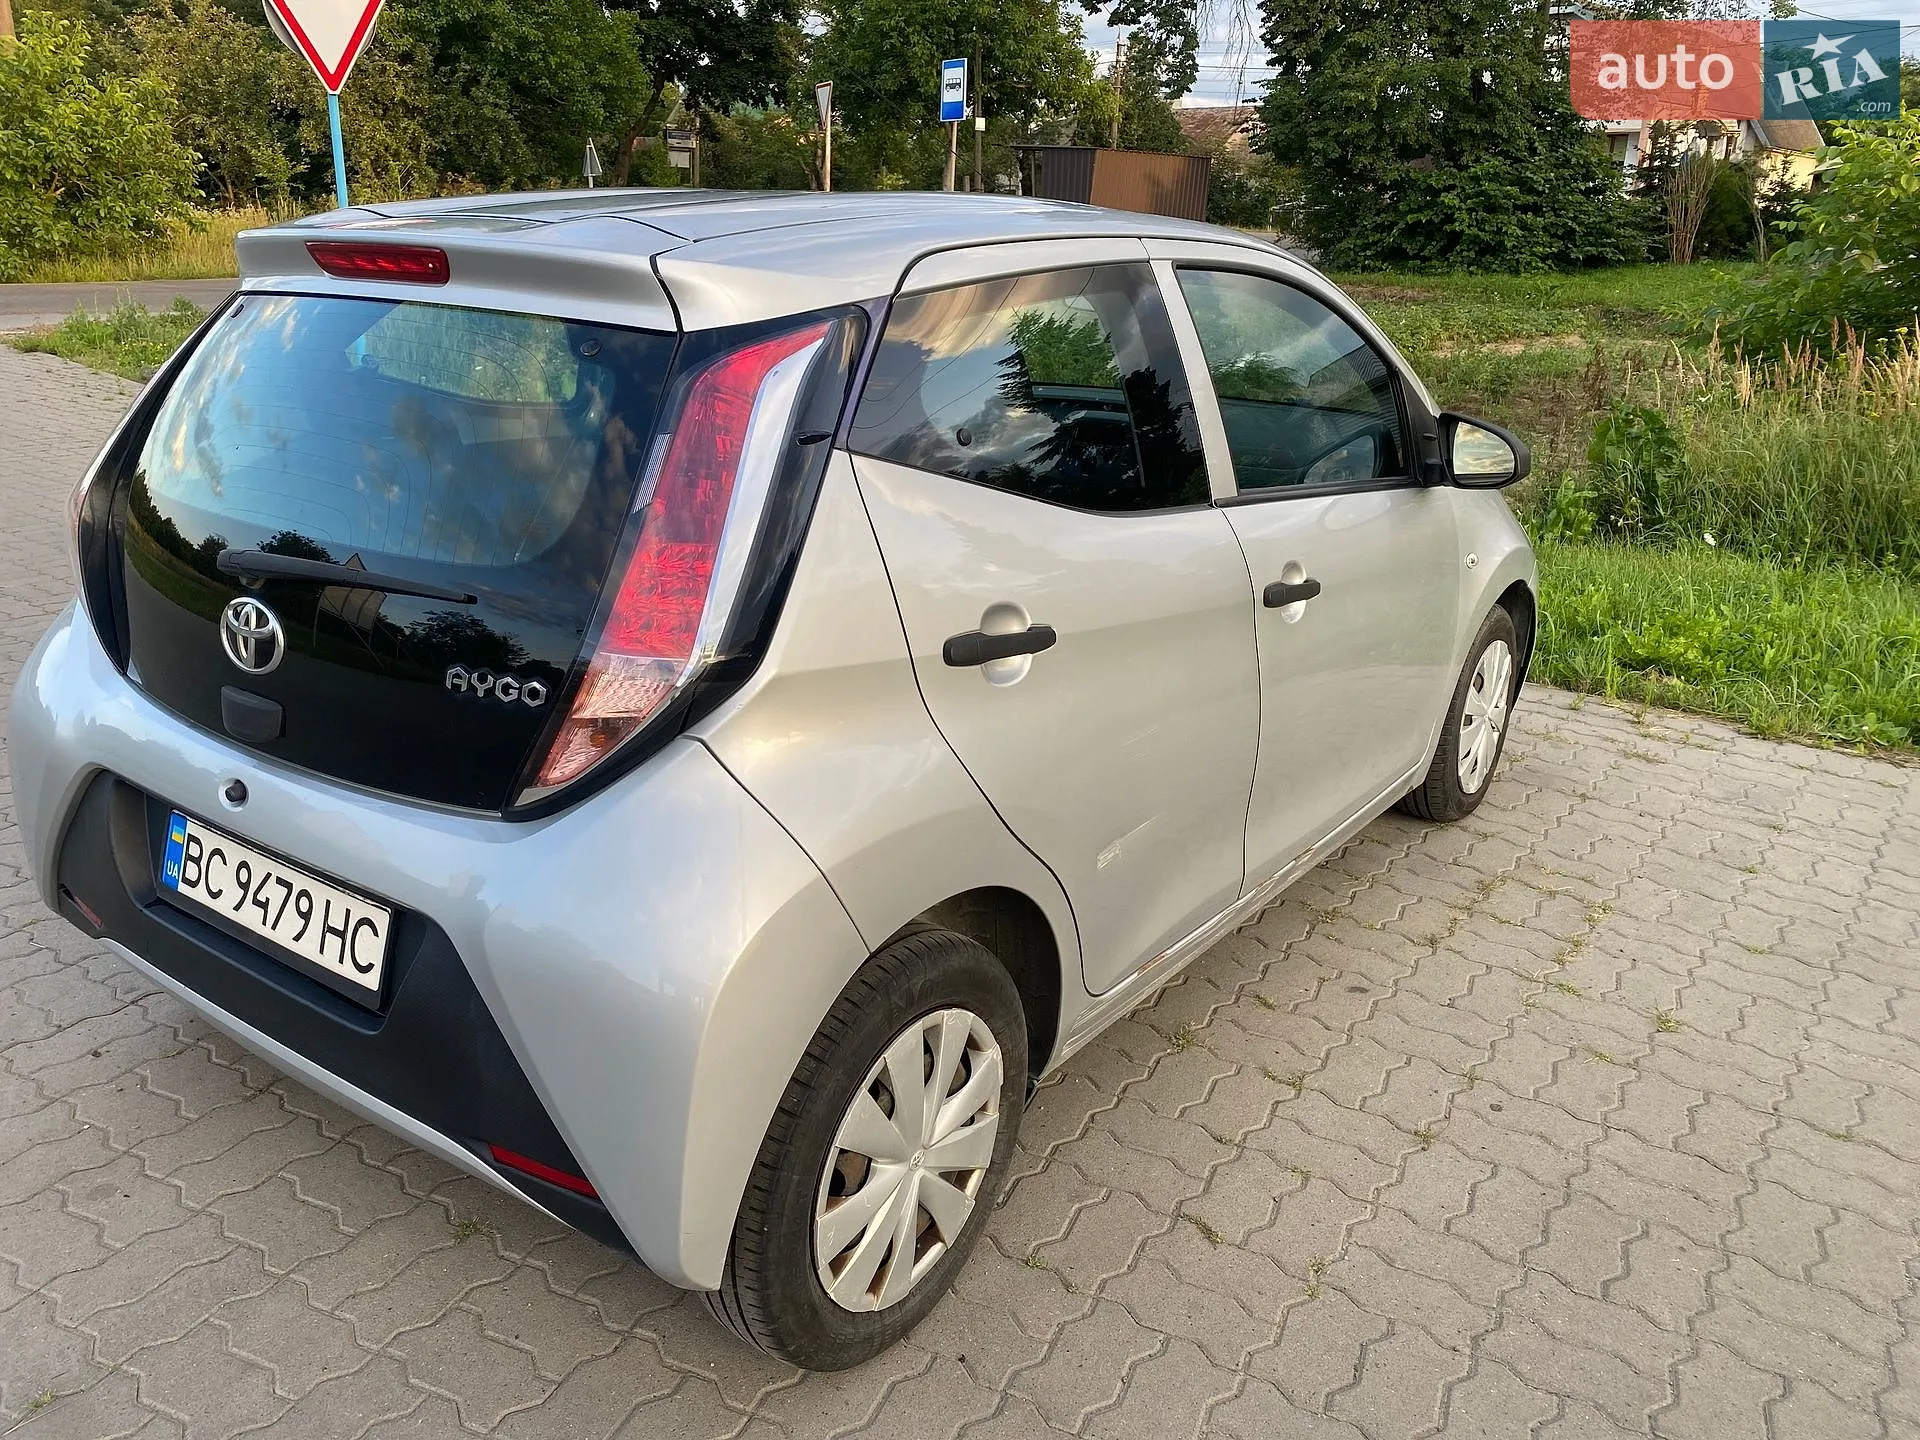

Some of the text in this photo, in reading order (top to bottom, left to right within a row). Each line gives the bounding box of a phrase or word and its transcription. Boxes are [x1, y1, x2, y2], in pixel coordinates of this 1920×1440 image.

[445, 666, 547, 708] AYGO
[166, 859, 179, 880] UA
[181, 832, 380, 975] BC 9479 HC
